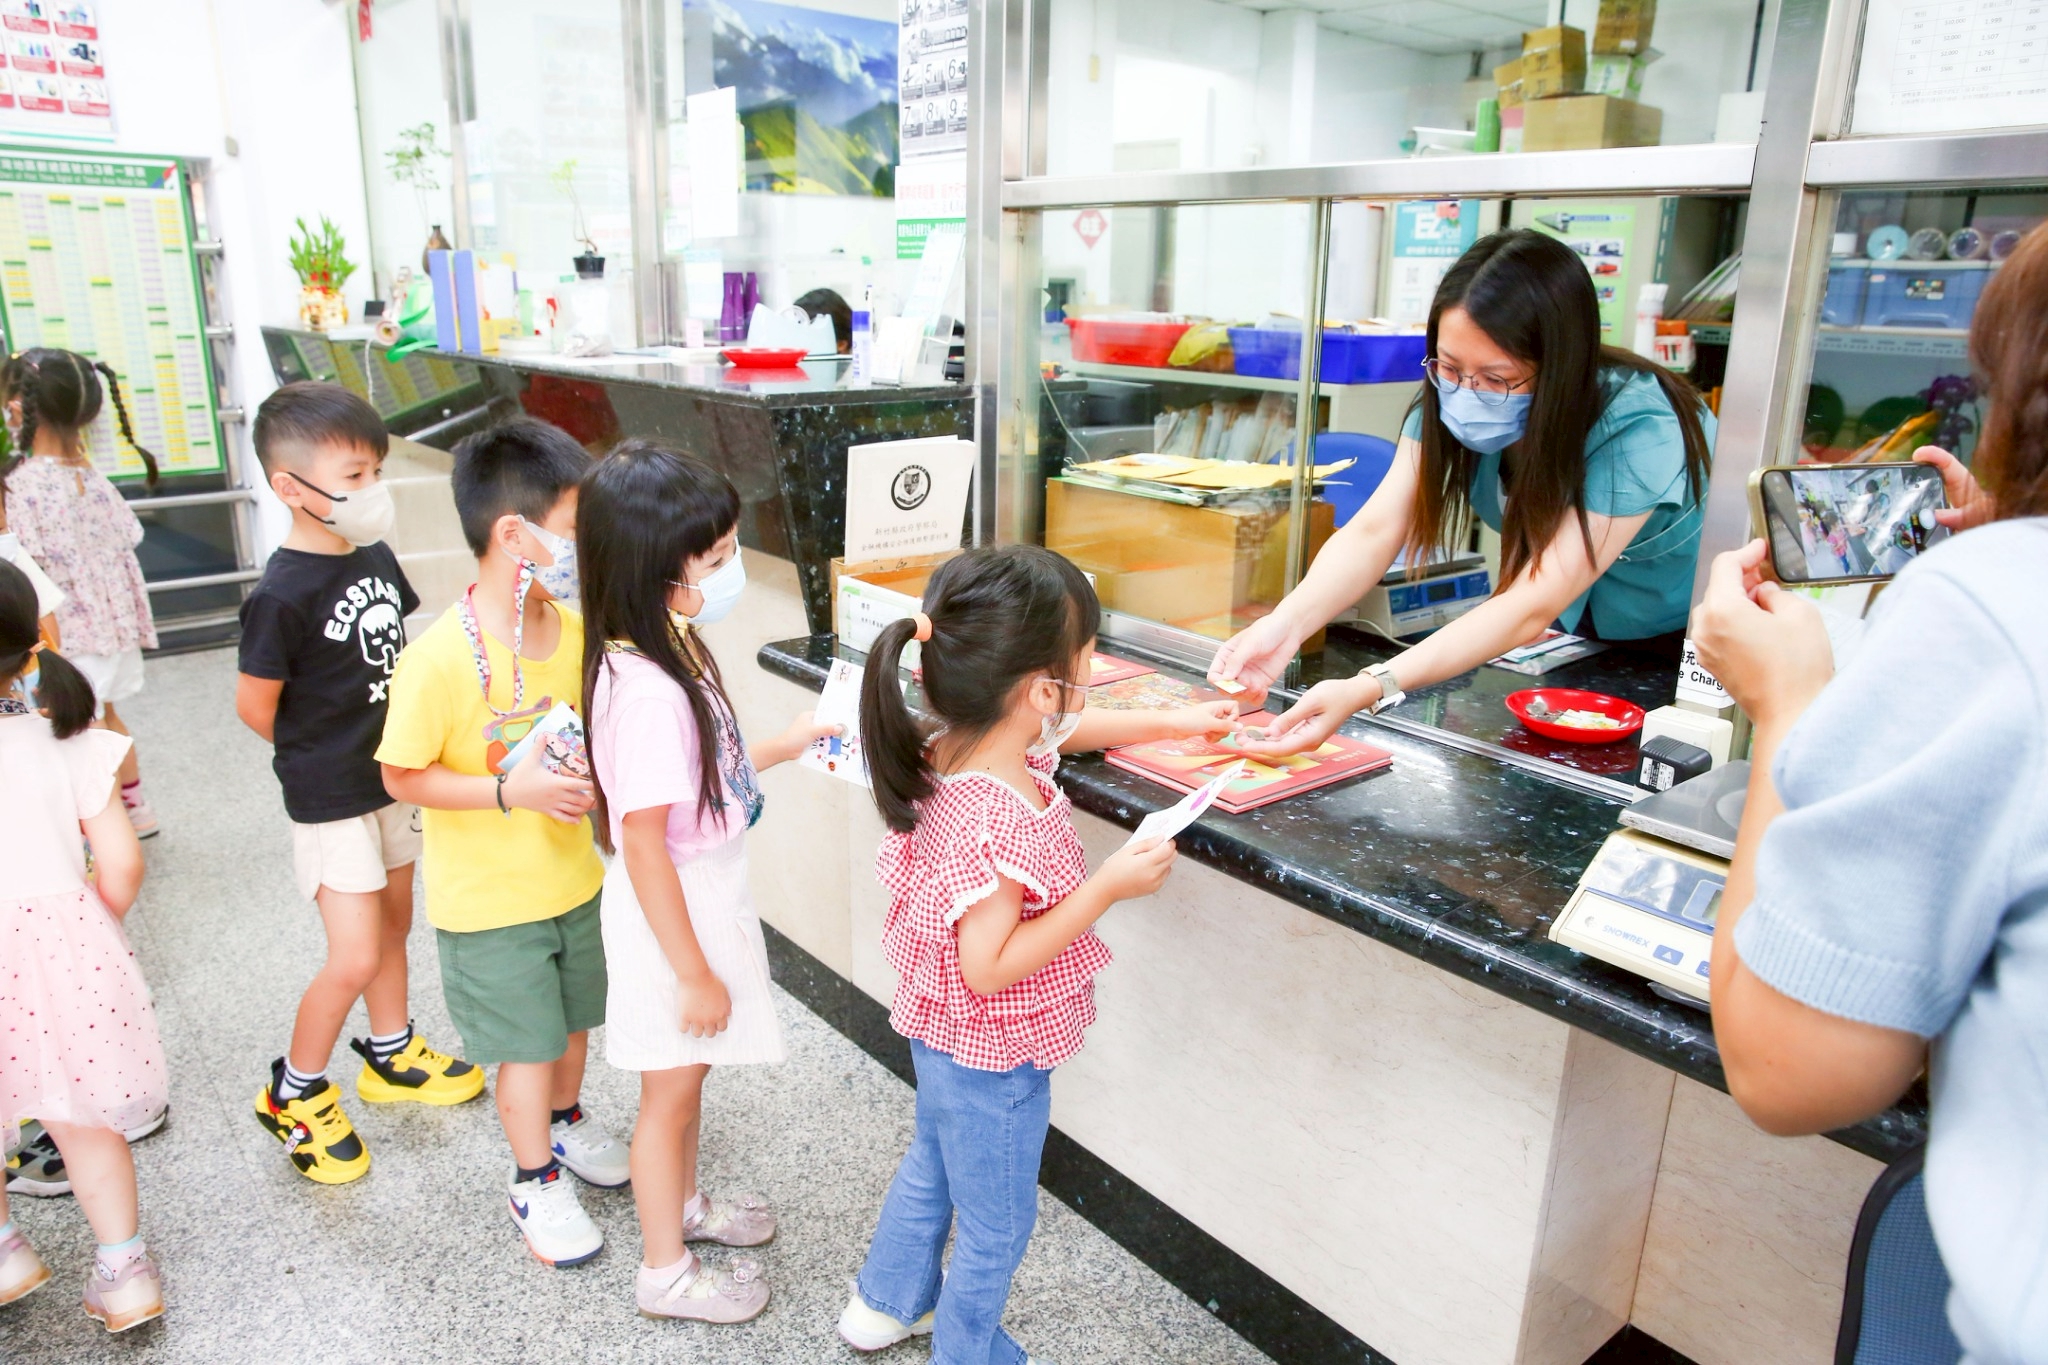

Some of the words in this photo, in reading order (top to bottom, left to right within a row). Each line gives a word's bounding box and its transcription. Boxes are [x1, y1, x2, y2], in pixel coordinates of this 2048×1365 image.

[948, 58, 957, 80] 6
[949, 98, 957, 119] 9
[1690, 671, 1724, 691] Charg
[1602, 924, 1651, 949] SNOWREX
